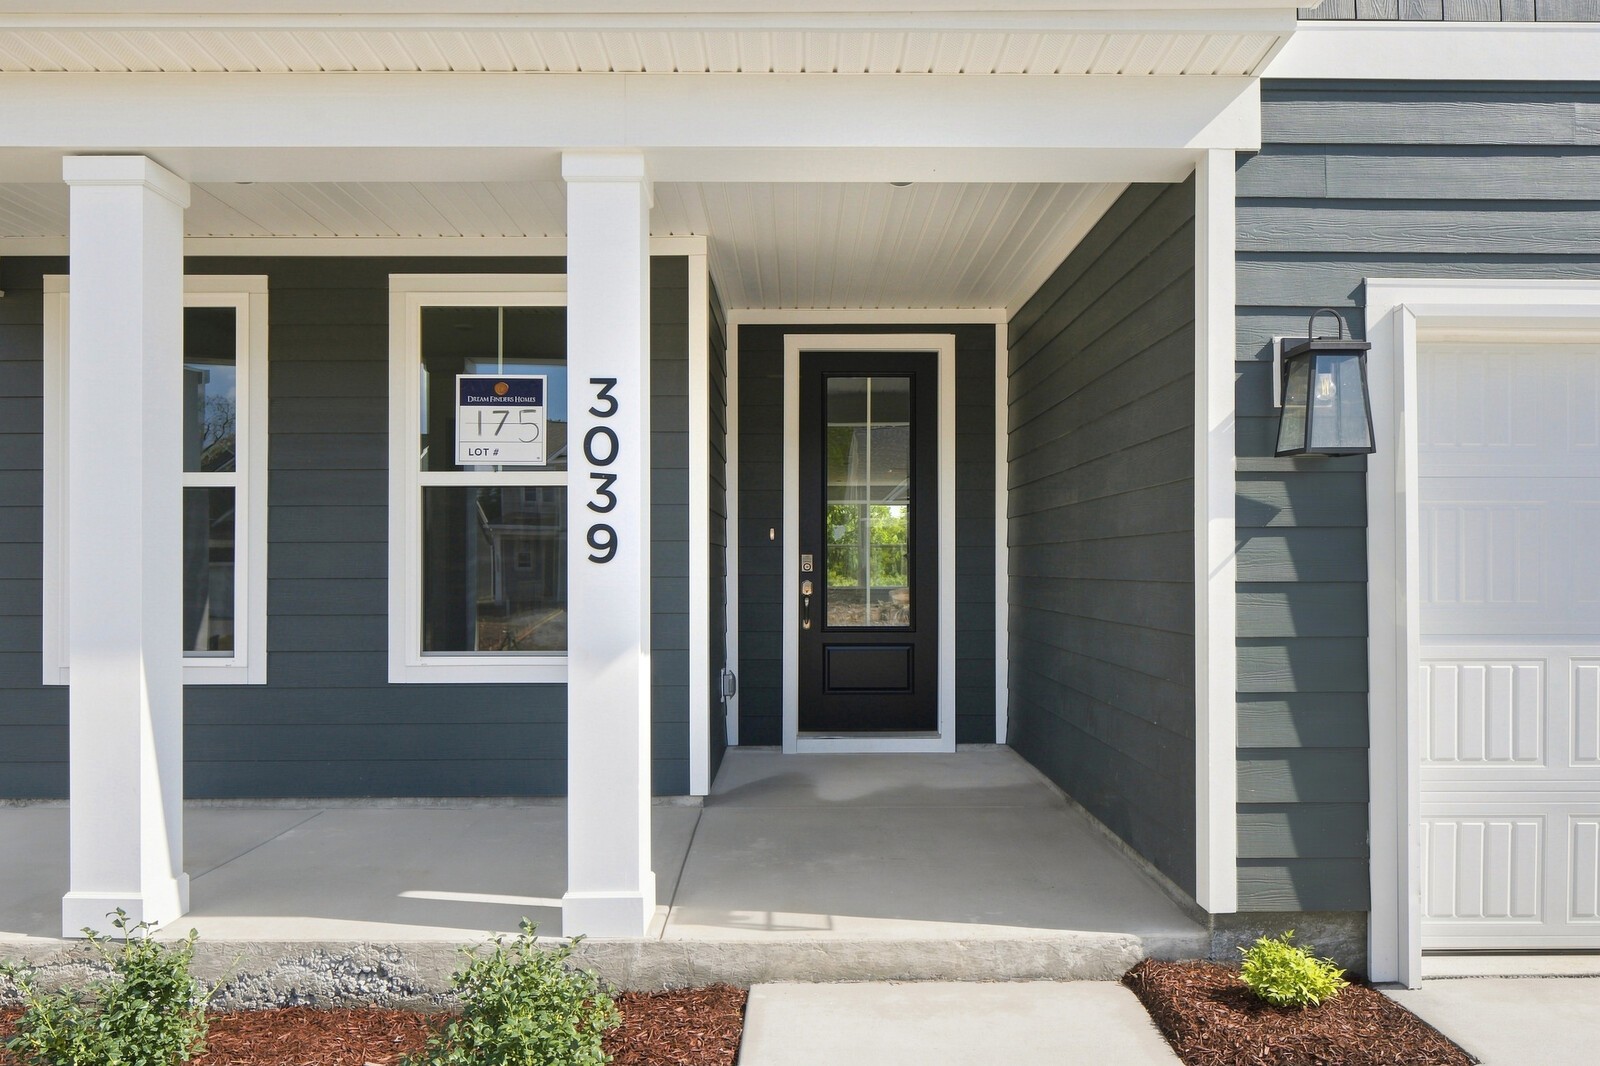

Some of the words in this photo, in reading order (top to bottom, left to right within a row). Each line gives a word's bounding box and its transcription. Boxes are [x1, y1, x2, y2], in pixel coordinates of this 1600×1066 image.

[467, 395, 490, 403] DREAM
[490, 395, 514, 403] FINDERS
[514, 395, 536, 403] HOMES
[477, 409, 540, 443] 175
[468, 448, 490, 456] LOT
[583, 377, 620, 564] 3039
